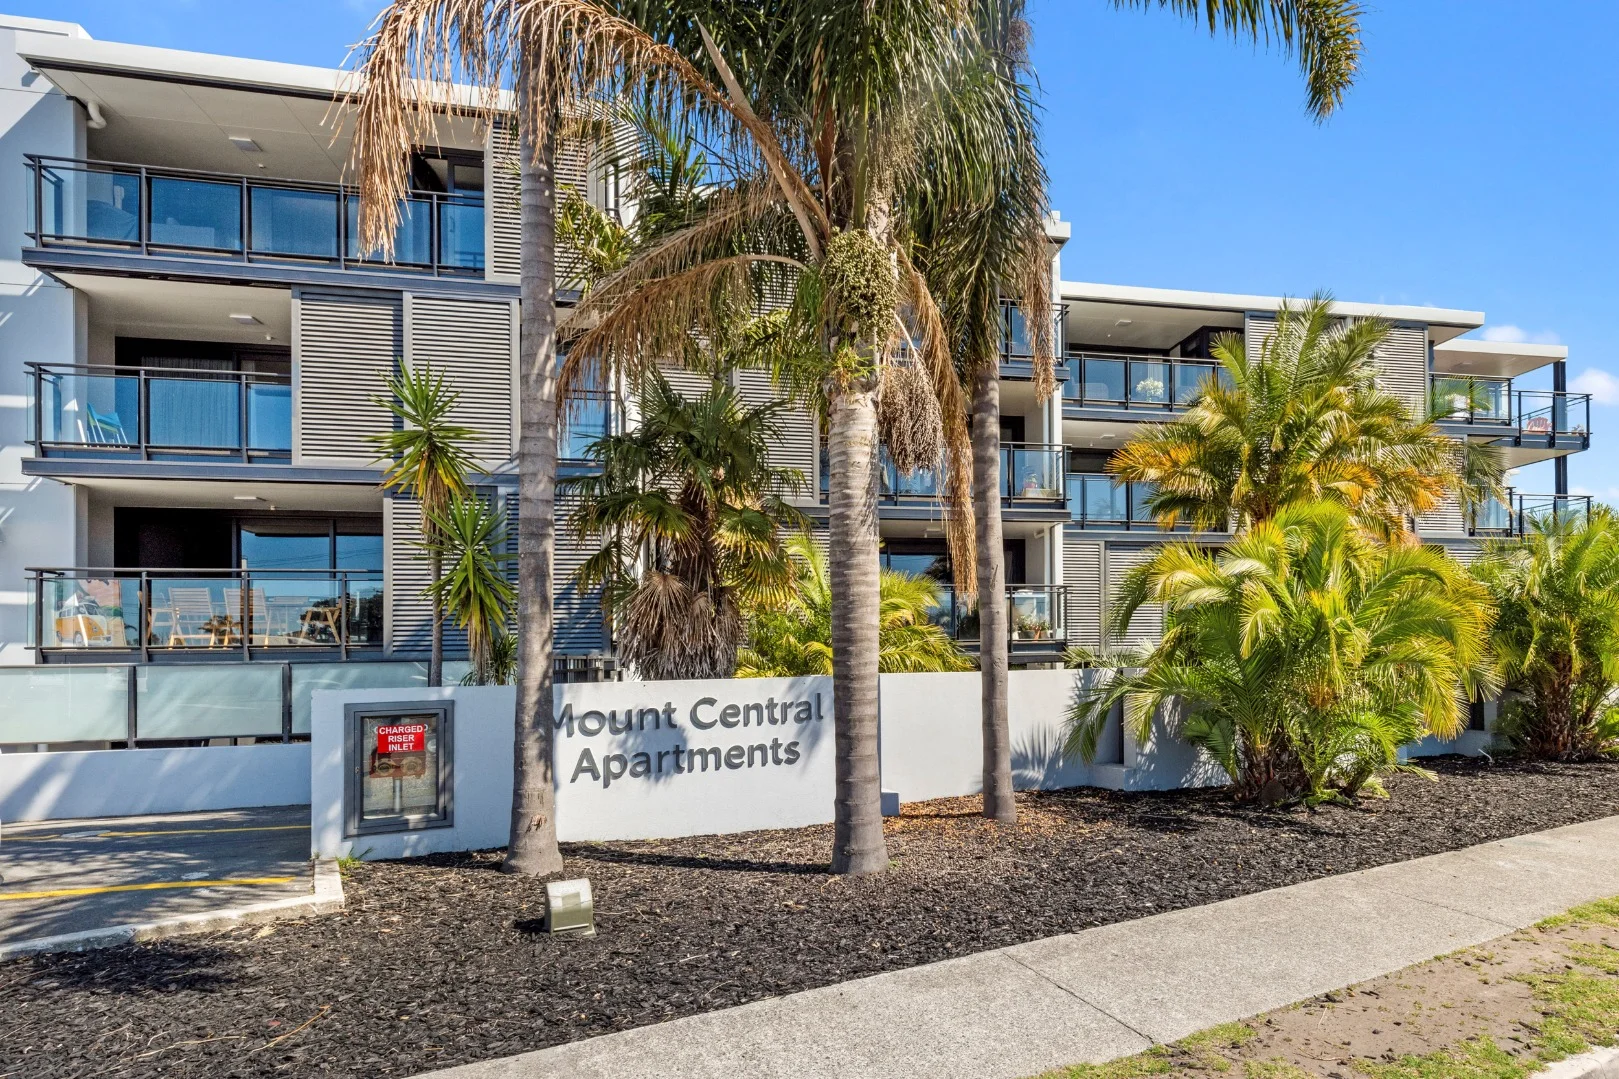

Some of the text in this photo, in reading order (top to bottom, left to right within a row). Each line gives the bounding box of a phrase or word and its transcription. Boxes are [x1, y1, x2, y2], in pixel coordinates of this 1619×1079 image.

[690, 692, 824, 730] Central
[379, 725, 423, 734] CHARGED
[389, 743, 414, 751] INLET
[570, 737, 801, 788] Apartments
